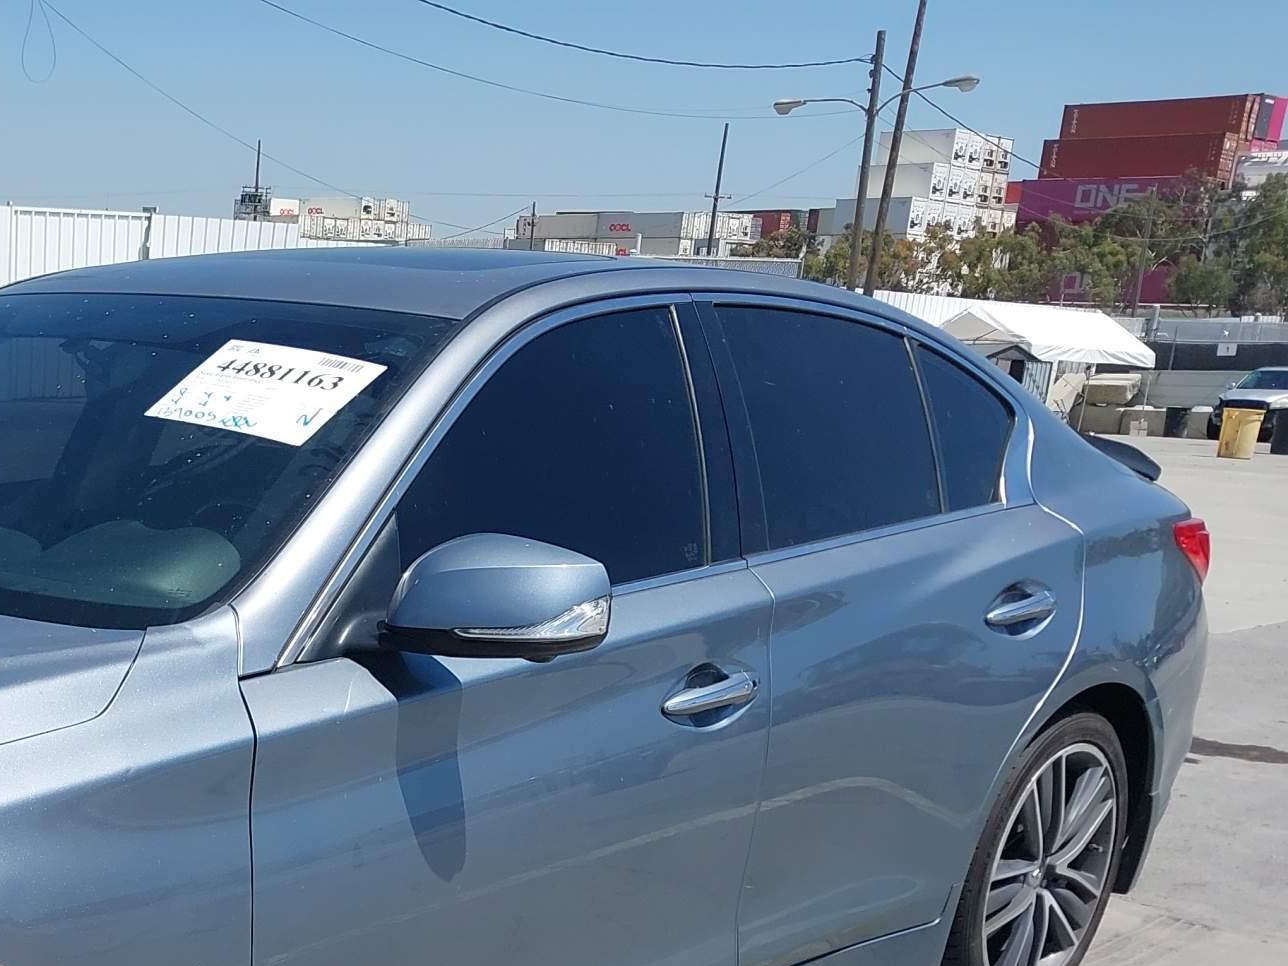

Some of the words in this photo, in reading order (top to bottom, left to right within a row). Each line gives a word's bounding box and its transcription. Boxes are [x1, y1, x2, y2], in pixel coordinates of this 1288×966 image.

[1074, 183, 1142, 208] ONE
[609, 223, 631, 232] OOCL
[217, 358, 345, 390] 44881163
